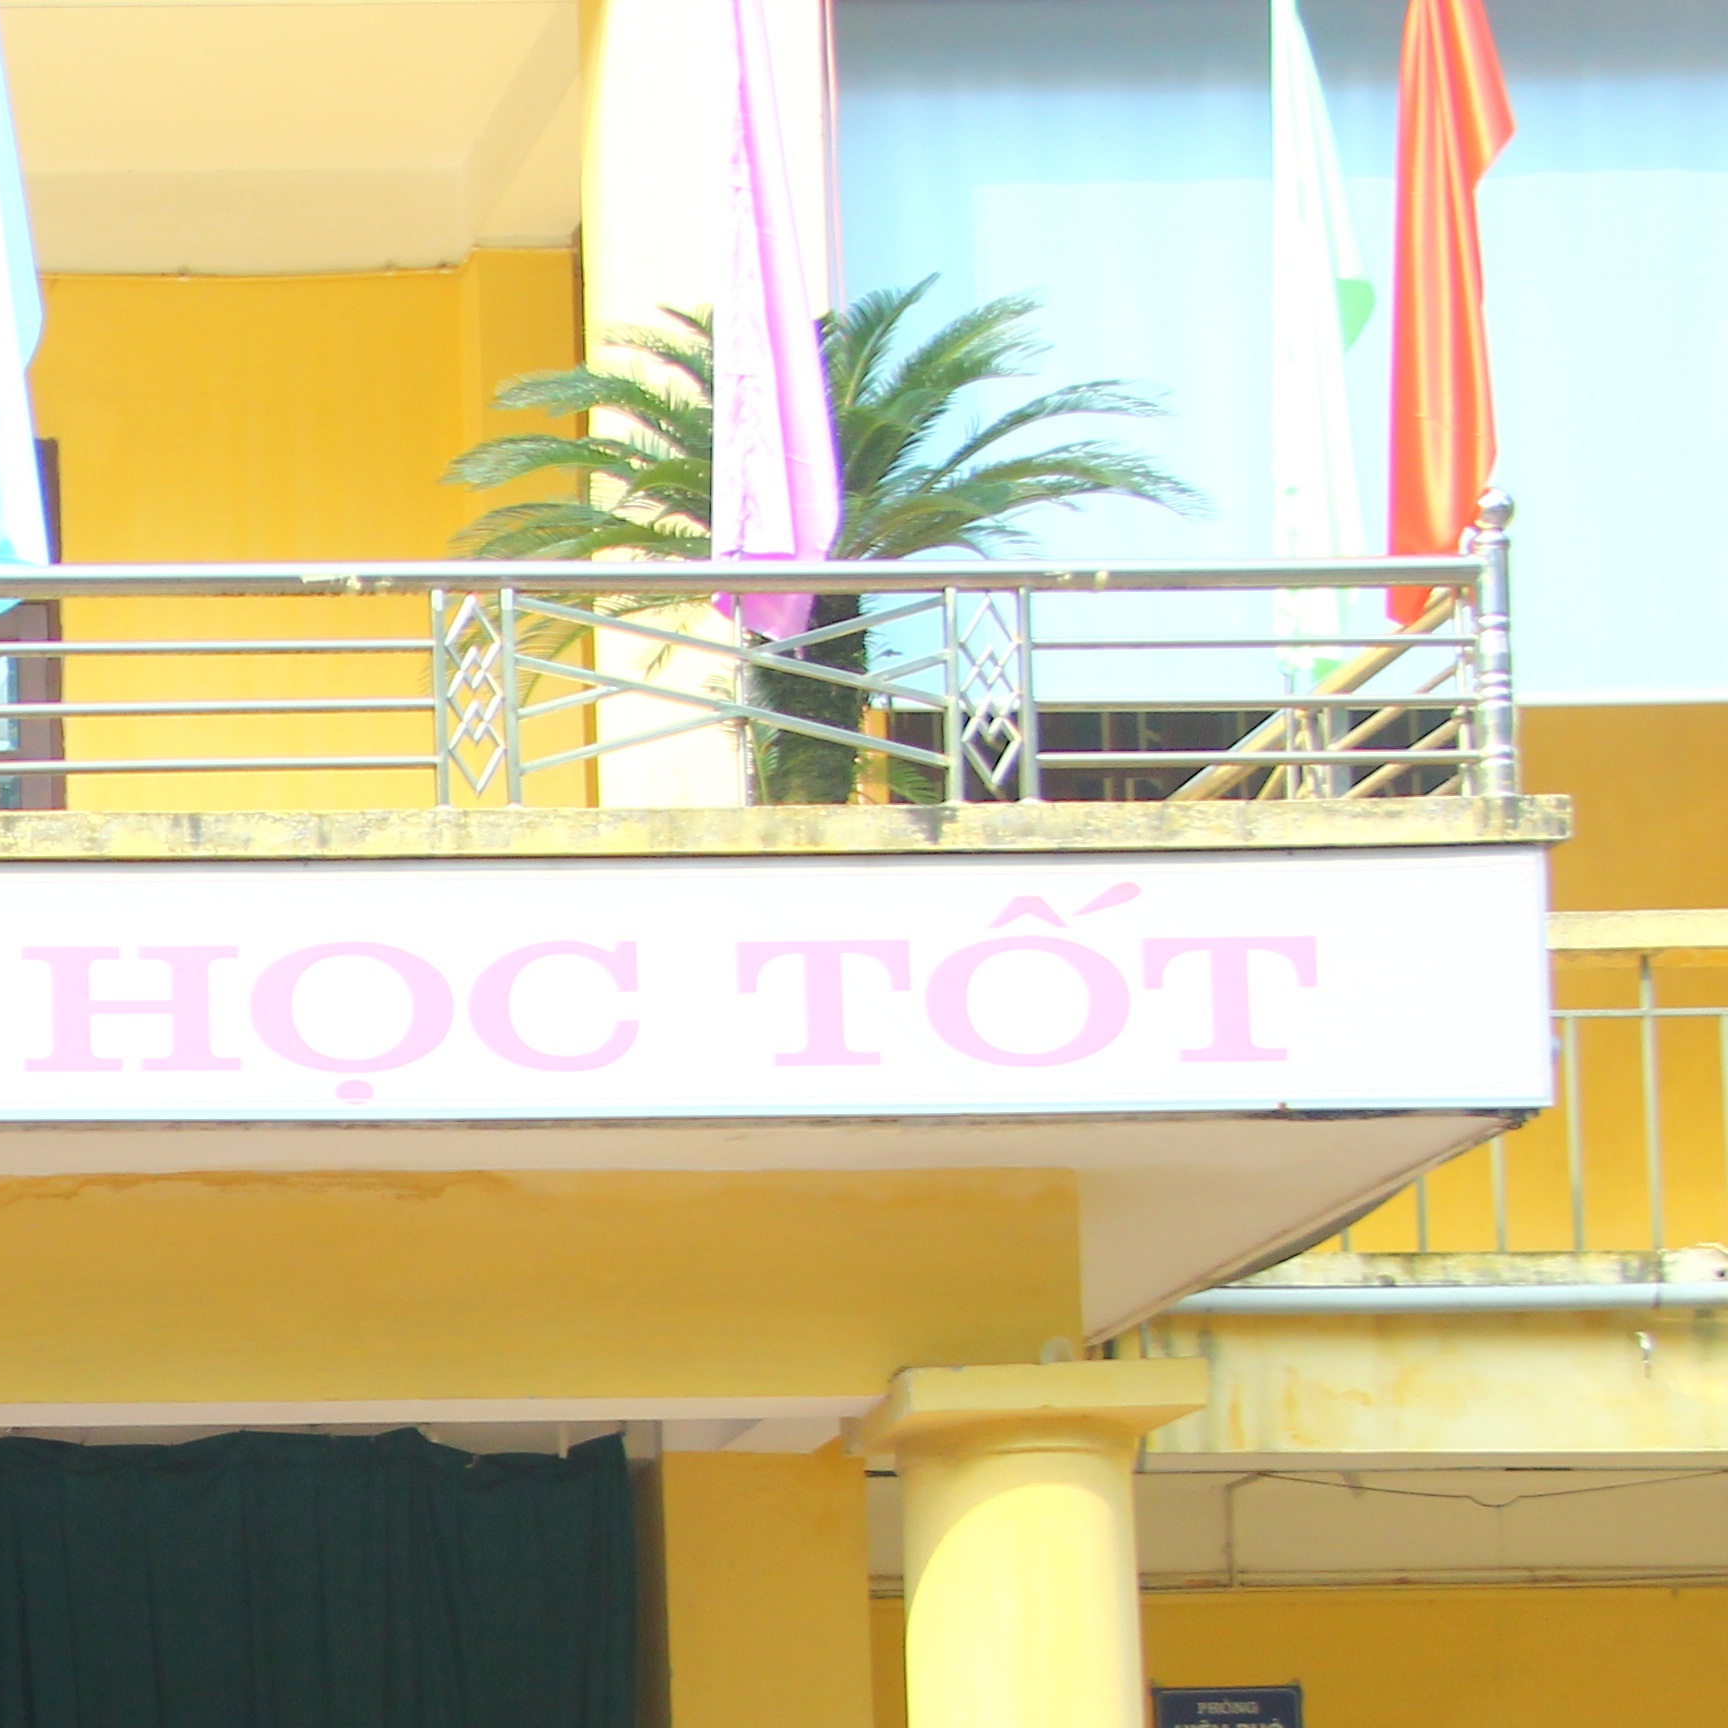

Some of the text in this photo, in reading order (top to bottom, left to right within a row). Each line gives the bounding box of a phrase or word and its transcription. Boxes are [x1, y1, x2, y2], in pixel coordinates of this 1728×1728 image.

[20, 939, 640, 1105] HỌC
[736, 881, 1319, 1068] TỐT
[1196, 1698, 1260, 1715] PHÒNG
